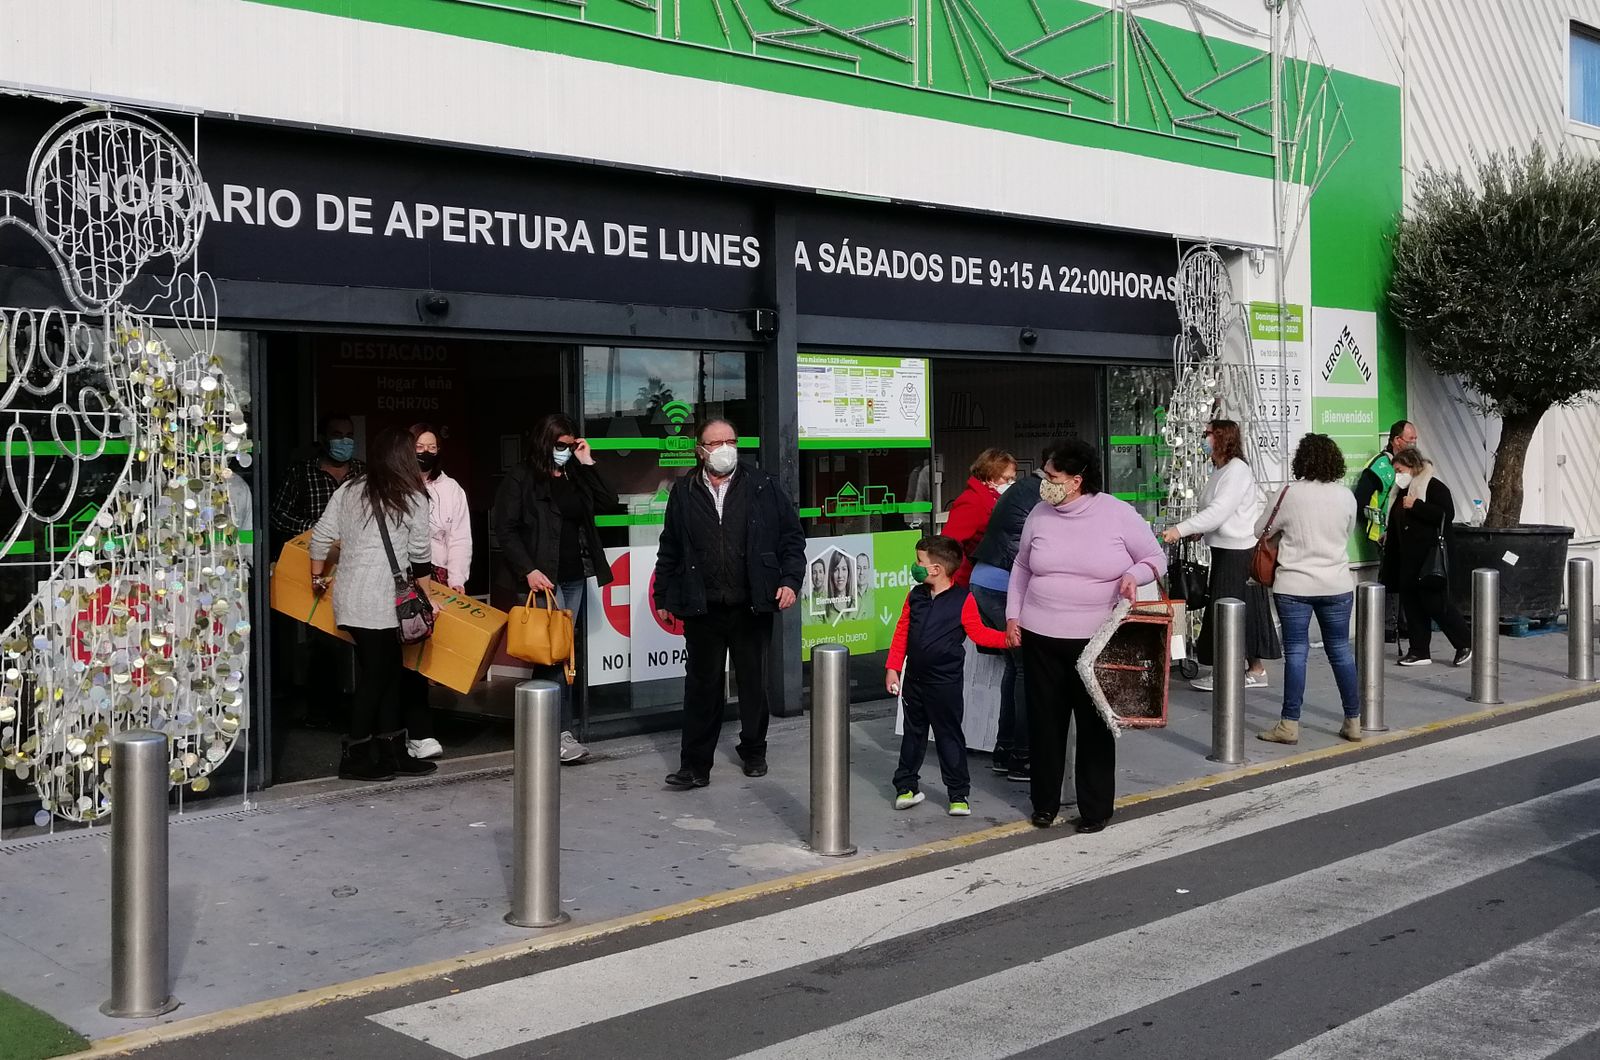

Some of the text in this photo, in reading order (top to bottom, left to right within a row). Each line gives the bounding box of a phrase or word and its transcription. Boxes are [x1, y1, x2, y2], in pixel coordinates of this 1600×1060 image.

[76, 169, 301, 229] HORARIO
[316, 193, 374, 236] DE
[384, 201, 595, 255] APERTURA
[603, 222, 649, 259] DE
[659, 228, 761, 269] LUNES
[794, 241, 812, 272] A
[818, 238, 944, 283] SÁBADOS
[951, 256, 983, 286] DE
[989, 259, 1034, 290] 9:15
[1038, 264, 1055, 292] A
[340, 341, 448, 361] DESTACADO
[1322, 335, 1344, 382] LEROY
[1342, 324, 1372, 382] MERLIN
[376, 375, 453, 392] Hogar leña
[1321, 409, 1374, 424] ¡Bienvenidos!
[845, 632, 868, 643] bueno
[602, 654, 624, 671] NO
[647, 650, 669, 667] NO
[672, 648, 688, 665] PA
